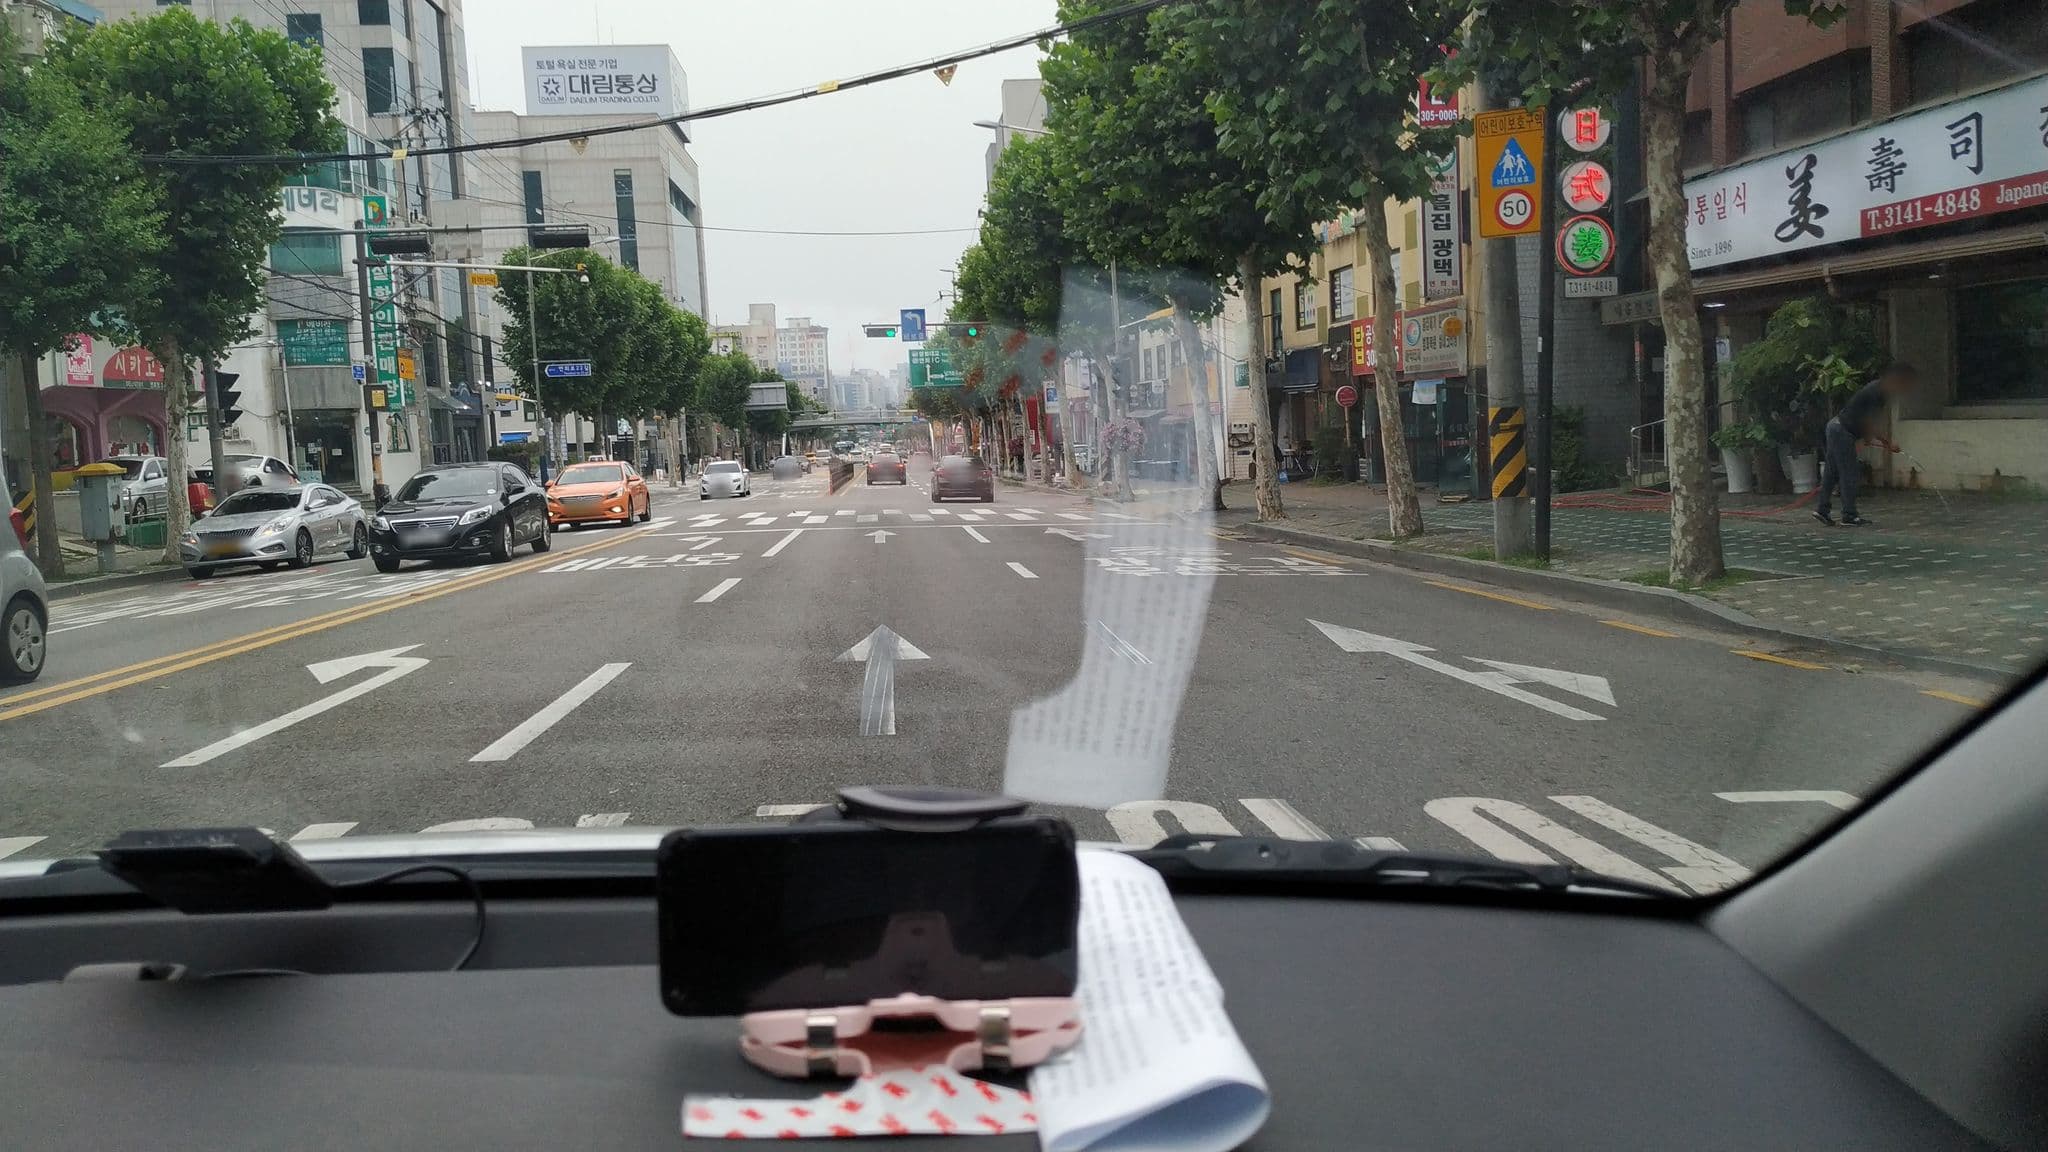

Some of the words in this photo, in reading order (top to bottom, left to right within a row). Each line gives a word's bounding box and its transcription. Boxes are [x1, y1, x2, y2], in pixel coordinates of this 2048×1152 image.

[578, 58, 597, 70] 전문
[598, 58, 618, 70] 기업
[568, 73, 658, 95] 대림통상
[1420, 109, 1458, 121] 305-0005
[1503, 199, 1528, 218] 50
[1867, 188, 1981, 231] T.3141-4848
[1432, 238, 1455, 277] 광택
[1691, 247, 1713, 260] Since
[1714, 240, 1733, 256] 1996
[115, 353, 164, 377] 시카고
[538, 552, 743, 573] 비보호
